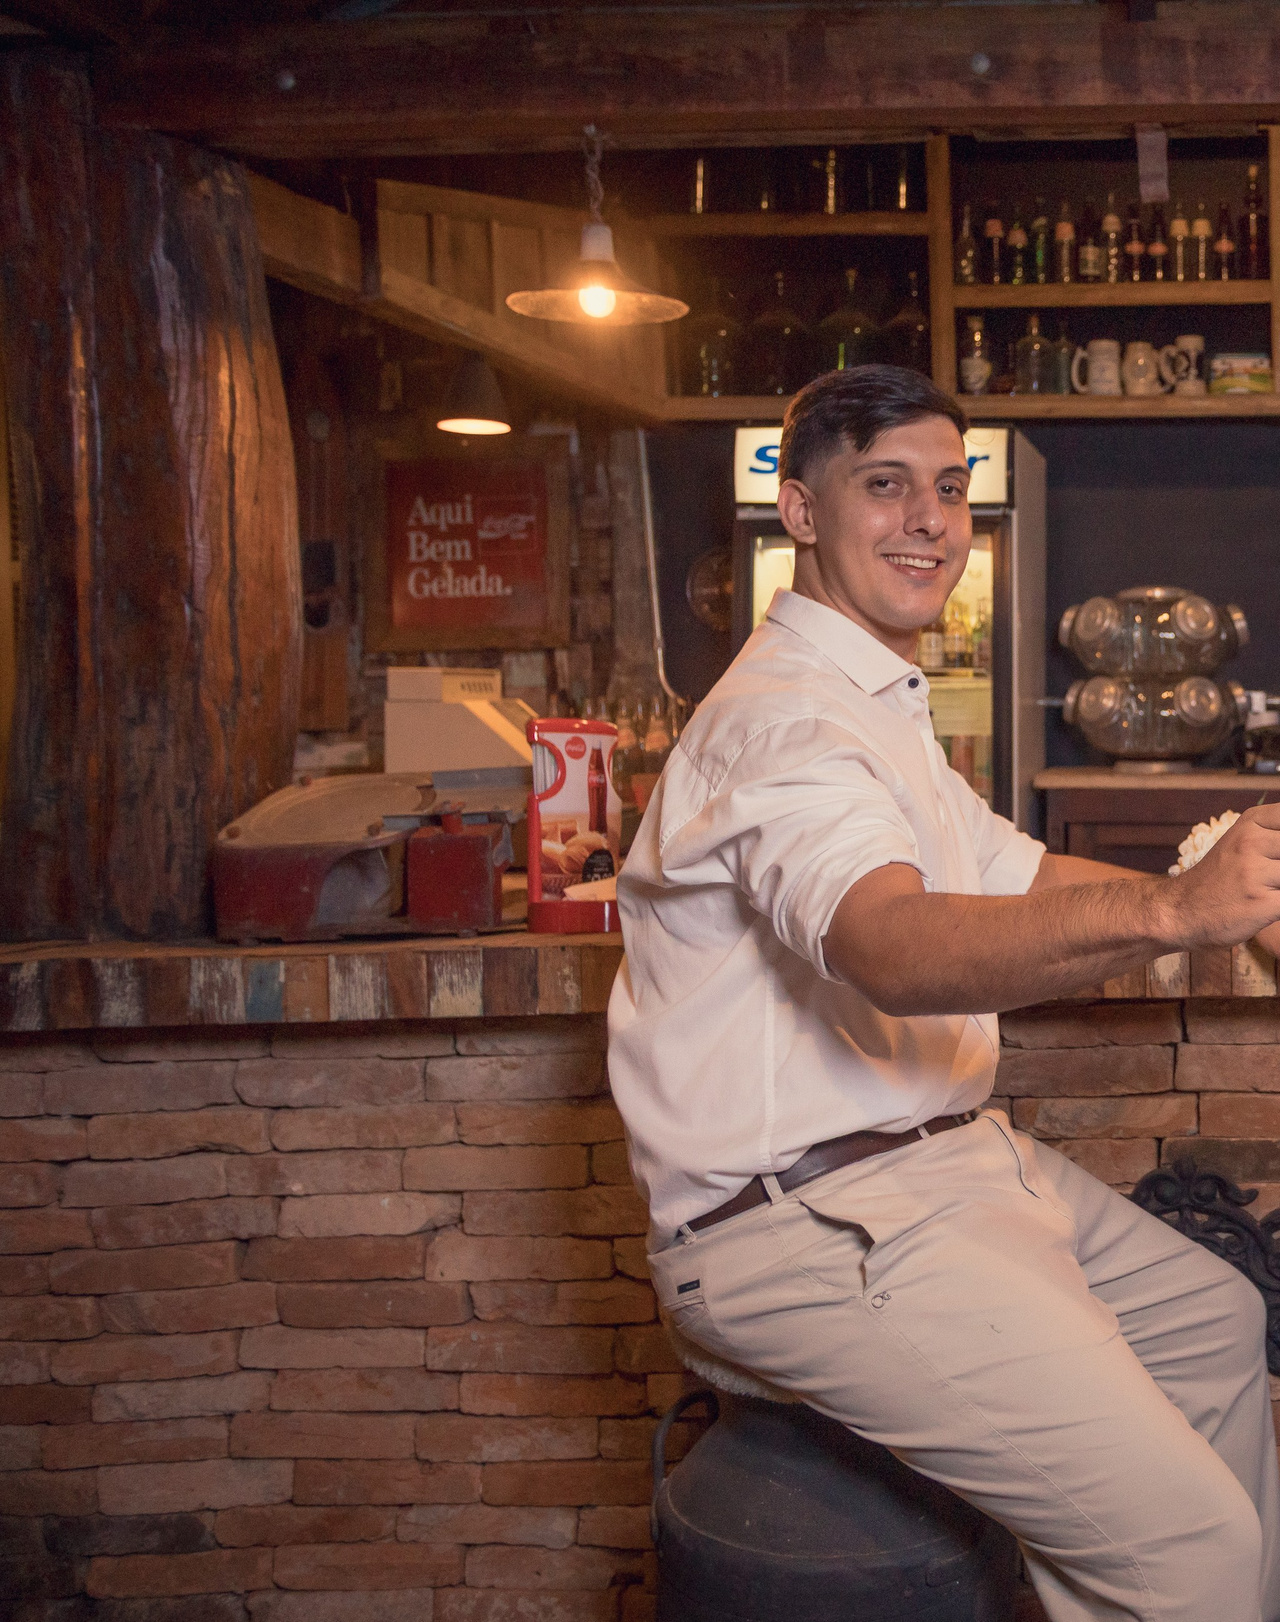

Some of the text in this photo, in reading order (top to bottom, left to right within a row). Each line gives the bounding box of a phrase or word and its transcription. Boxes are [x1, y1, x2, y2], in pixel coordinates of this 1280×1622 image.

[408, 494, 473, 531] Aqui
[407, 531, 472, 562] Bem
[407, 562, 513, 599] Gelada.
